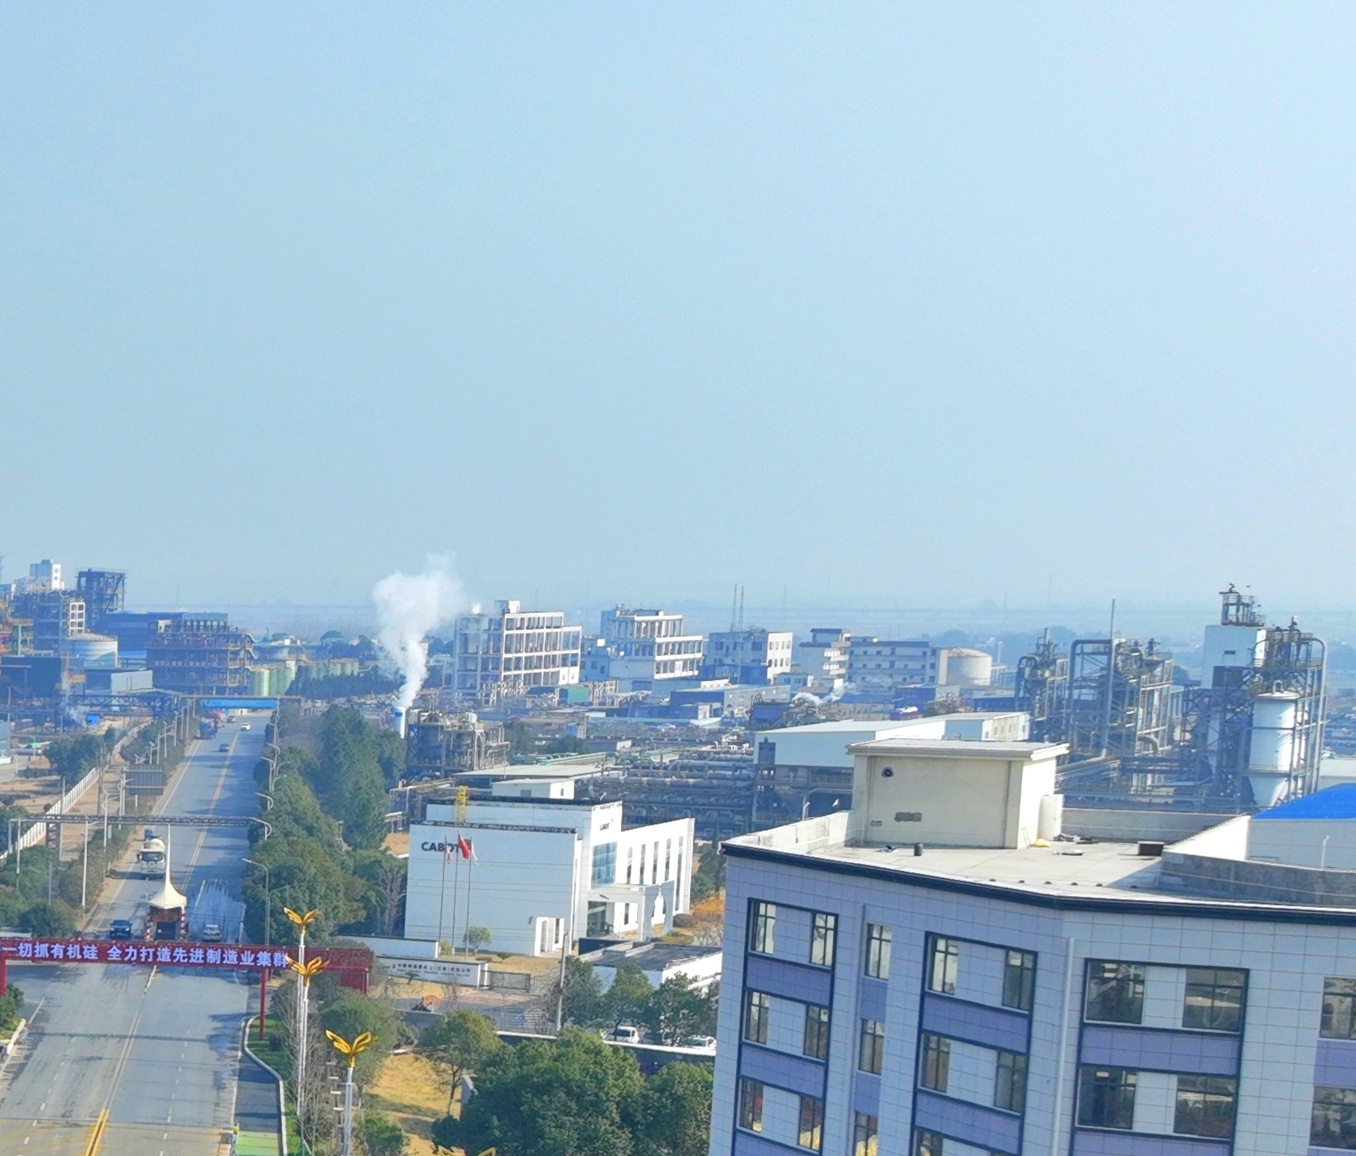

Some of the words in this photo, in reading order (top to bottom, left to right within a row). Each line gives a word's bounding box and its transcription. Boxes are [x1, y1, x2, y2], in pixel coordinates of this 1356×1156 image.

[421, 842, 460, 853] CABOT
[107, 947, 289, 968] 全力打造先进制造业集群
